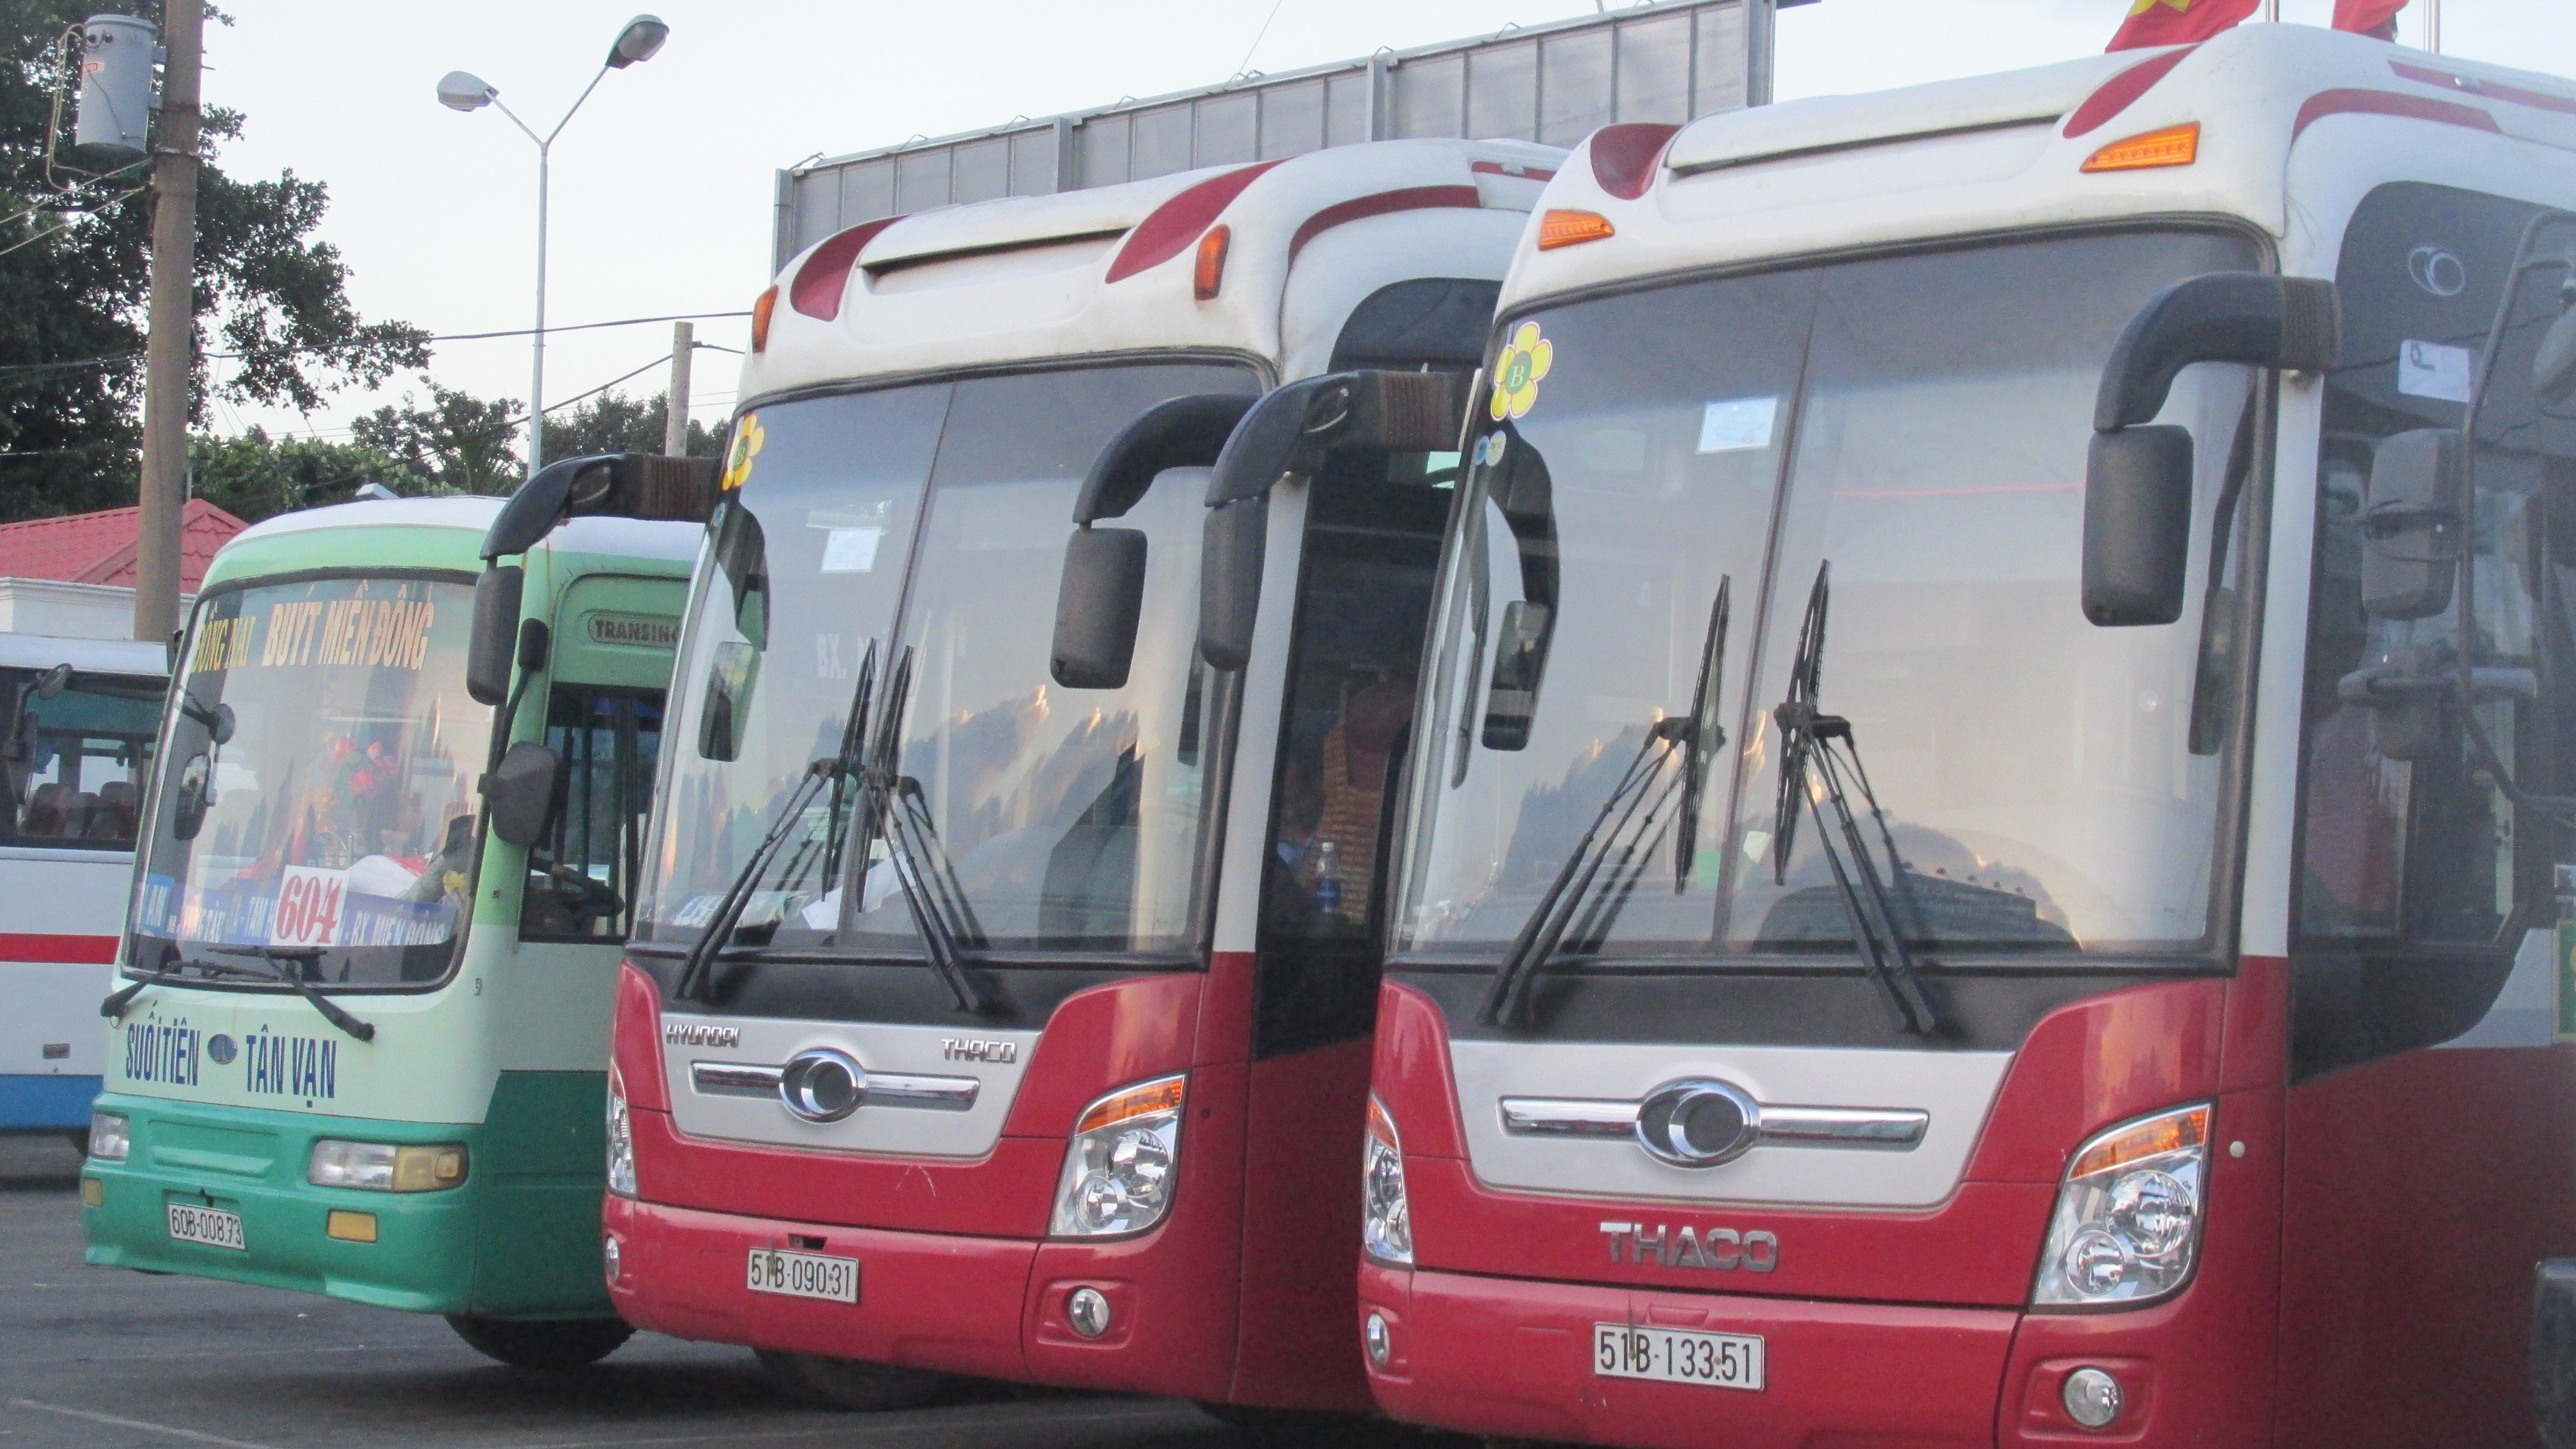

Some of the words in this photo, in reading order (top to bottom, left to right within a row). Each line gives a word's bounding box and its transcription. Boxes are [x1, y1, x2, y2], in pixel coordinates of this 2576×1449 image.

[276, 874, 343, 943] 604
[666, 1024, 740, 1048] HYUNDAI
[941, 1038, 1017, 1063] THACO
[246, 1023, 286, 1094] TÂN
[293, 1037, 337, 1107] VẠN
[1599, 1222, 1779, 1272] THACO
